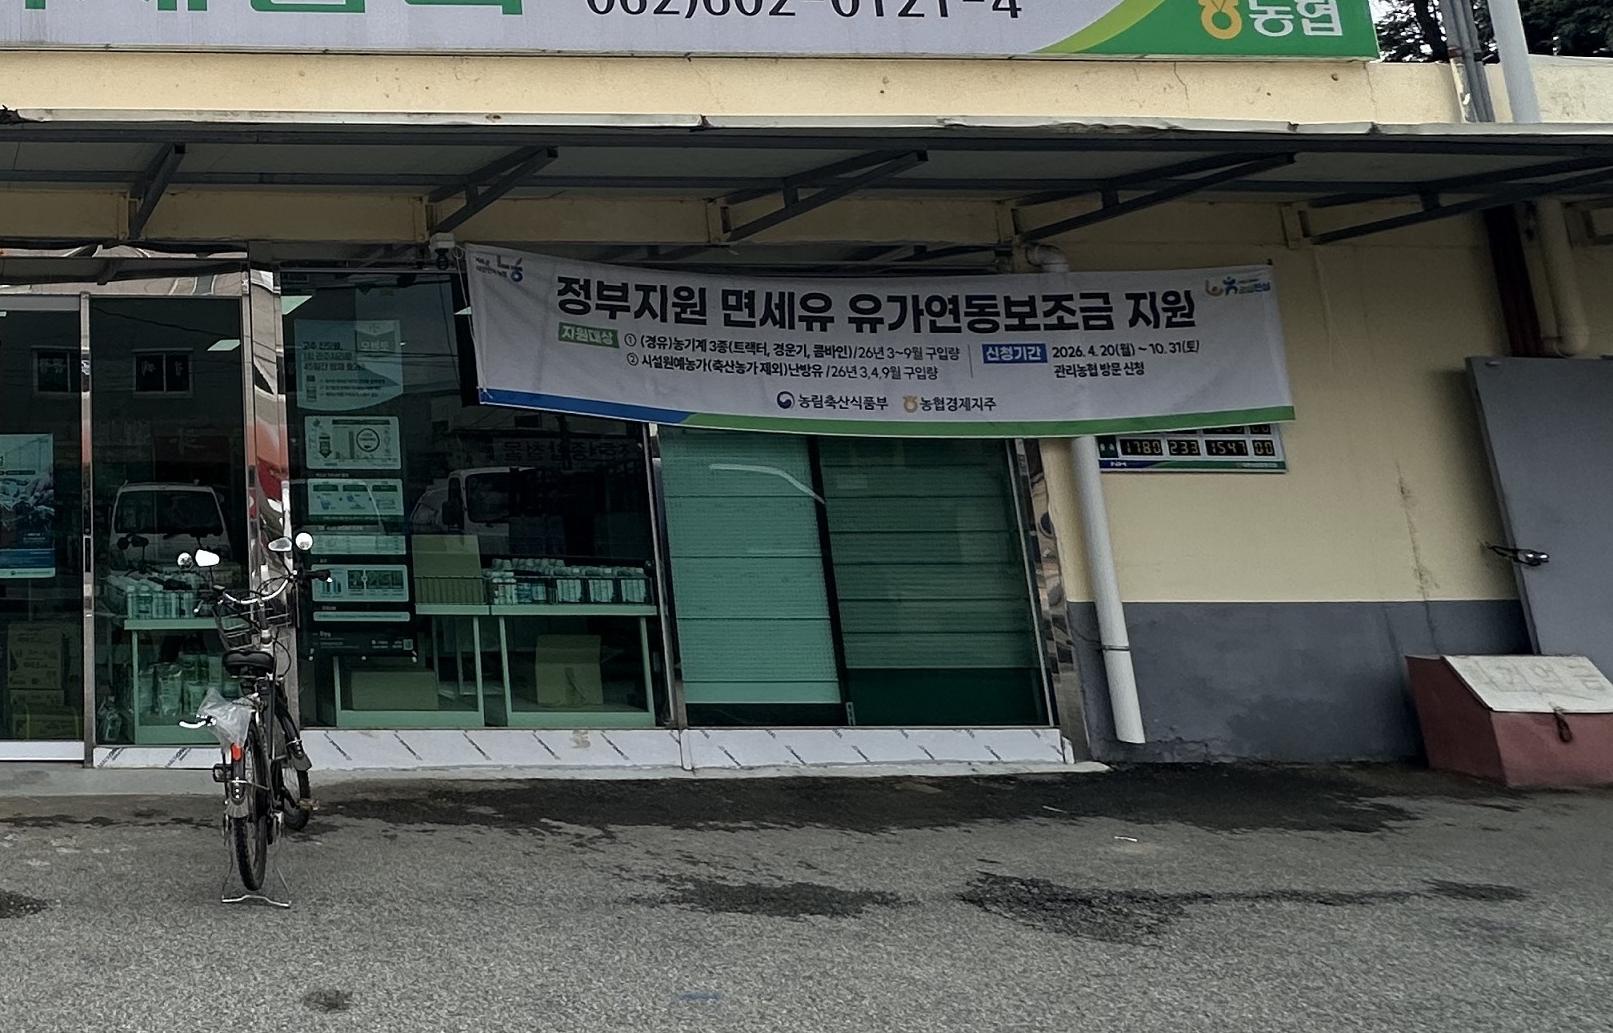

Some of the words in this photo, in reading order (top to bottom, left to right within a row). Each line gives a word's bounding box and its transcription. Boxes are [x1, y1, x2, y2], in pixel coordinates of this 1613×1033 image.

[556, 276, 708, 326] 정부지원
[720, 288, 835, 333] 면세유
[847, 291, 1115, 335] 유가연동보조금
[1124, 289, 1197, 330] 지원
[561, 324, 614, 346] 지원대상
[640, 334, 707, 354] (경유)농기계
[773, 341, 811, 359] 경운기,
[925, 346, 960, 363] 구입량
[985, 344, 1044, 363] 신청기간
[903, 365, 939, 382] 구입량
[1053, 363, 1098, 379] 관리농협
[798, 392, 889, 411] 농림축산식품부
[919, 395, 997, 412] 농협경제지주
[1169, 441, 1200, 455] 233
